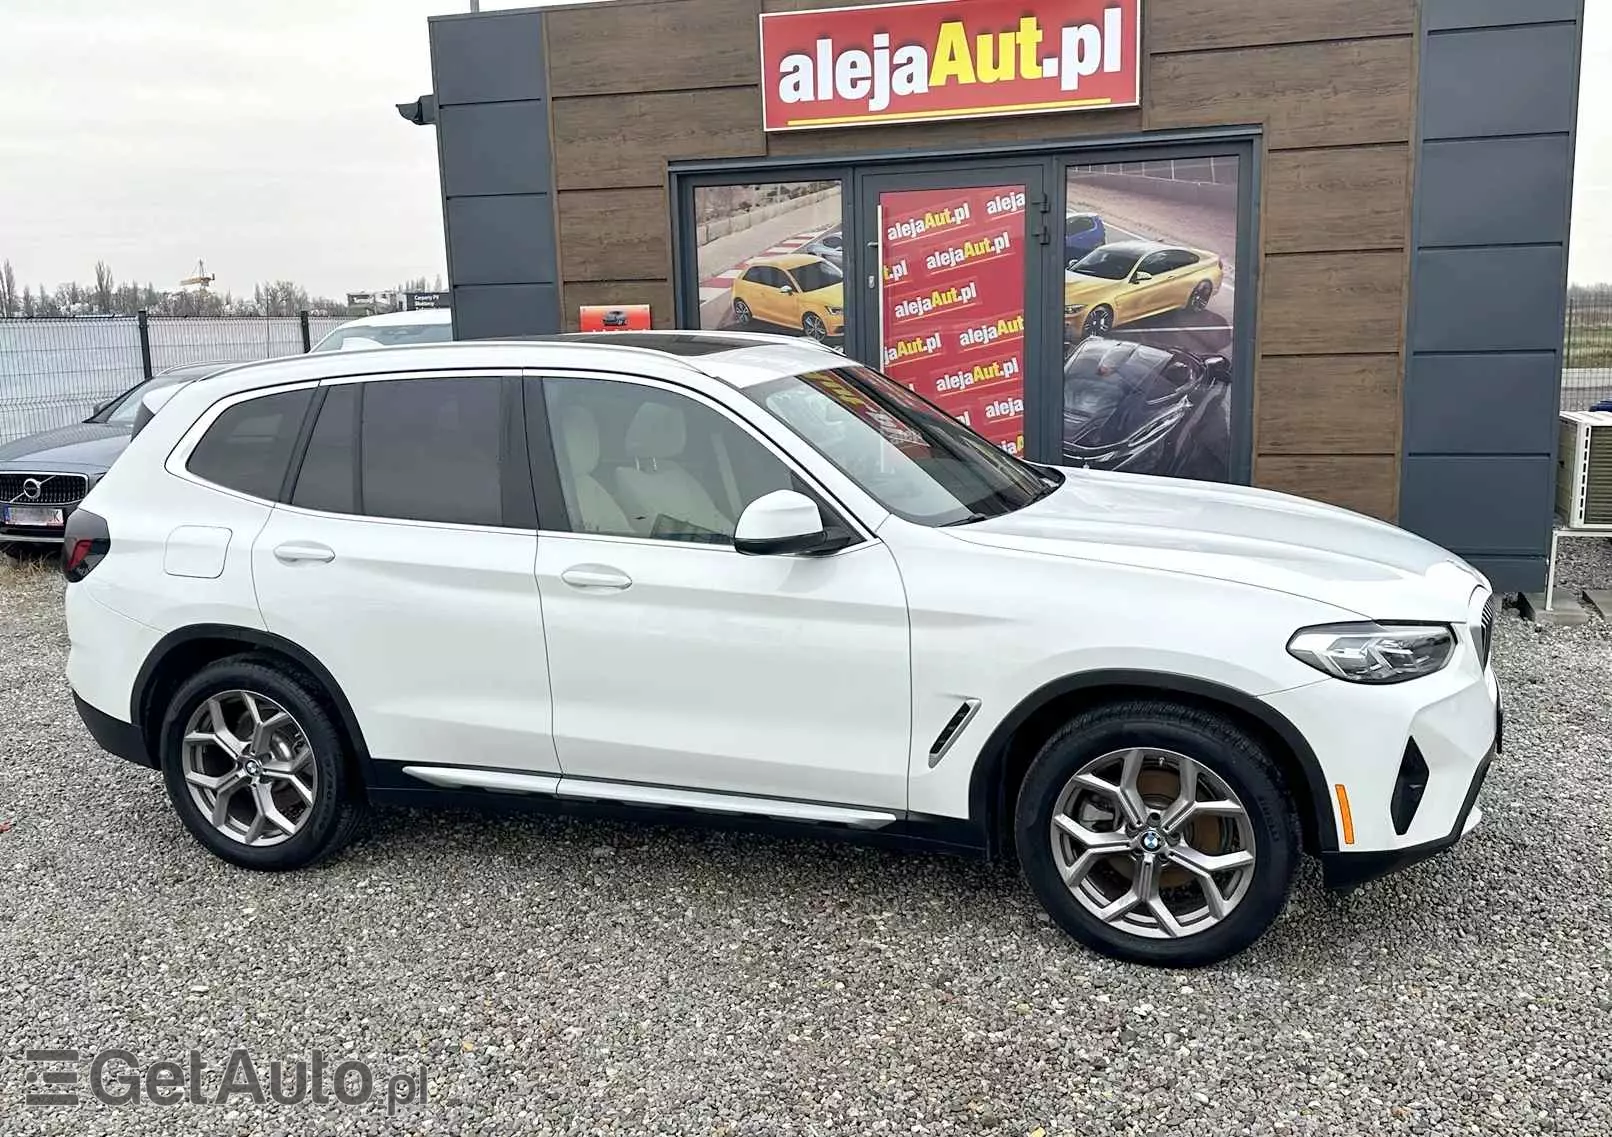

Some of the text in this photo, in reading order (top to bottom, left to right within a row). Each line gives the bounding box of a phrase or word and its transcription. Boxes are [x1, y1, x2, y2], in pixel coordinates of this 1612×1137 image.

[778, 7, 1122, 112] alejaAut.pl
[986, 192, 1025, 215] aleja
[887, 203, 971, 241] alejaAut.pl
[926, 232, 1011, 270] alejaAut.pl
[894, 282, 977, 318] alejaAut.pl
[959, 315, 1024, 346] alejaAut
[936, 357, 1019, 392] alejaAut.pl
[985, 397, 1024, 418] aleja
